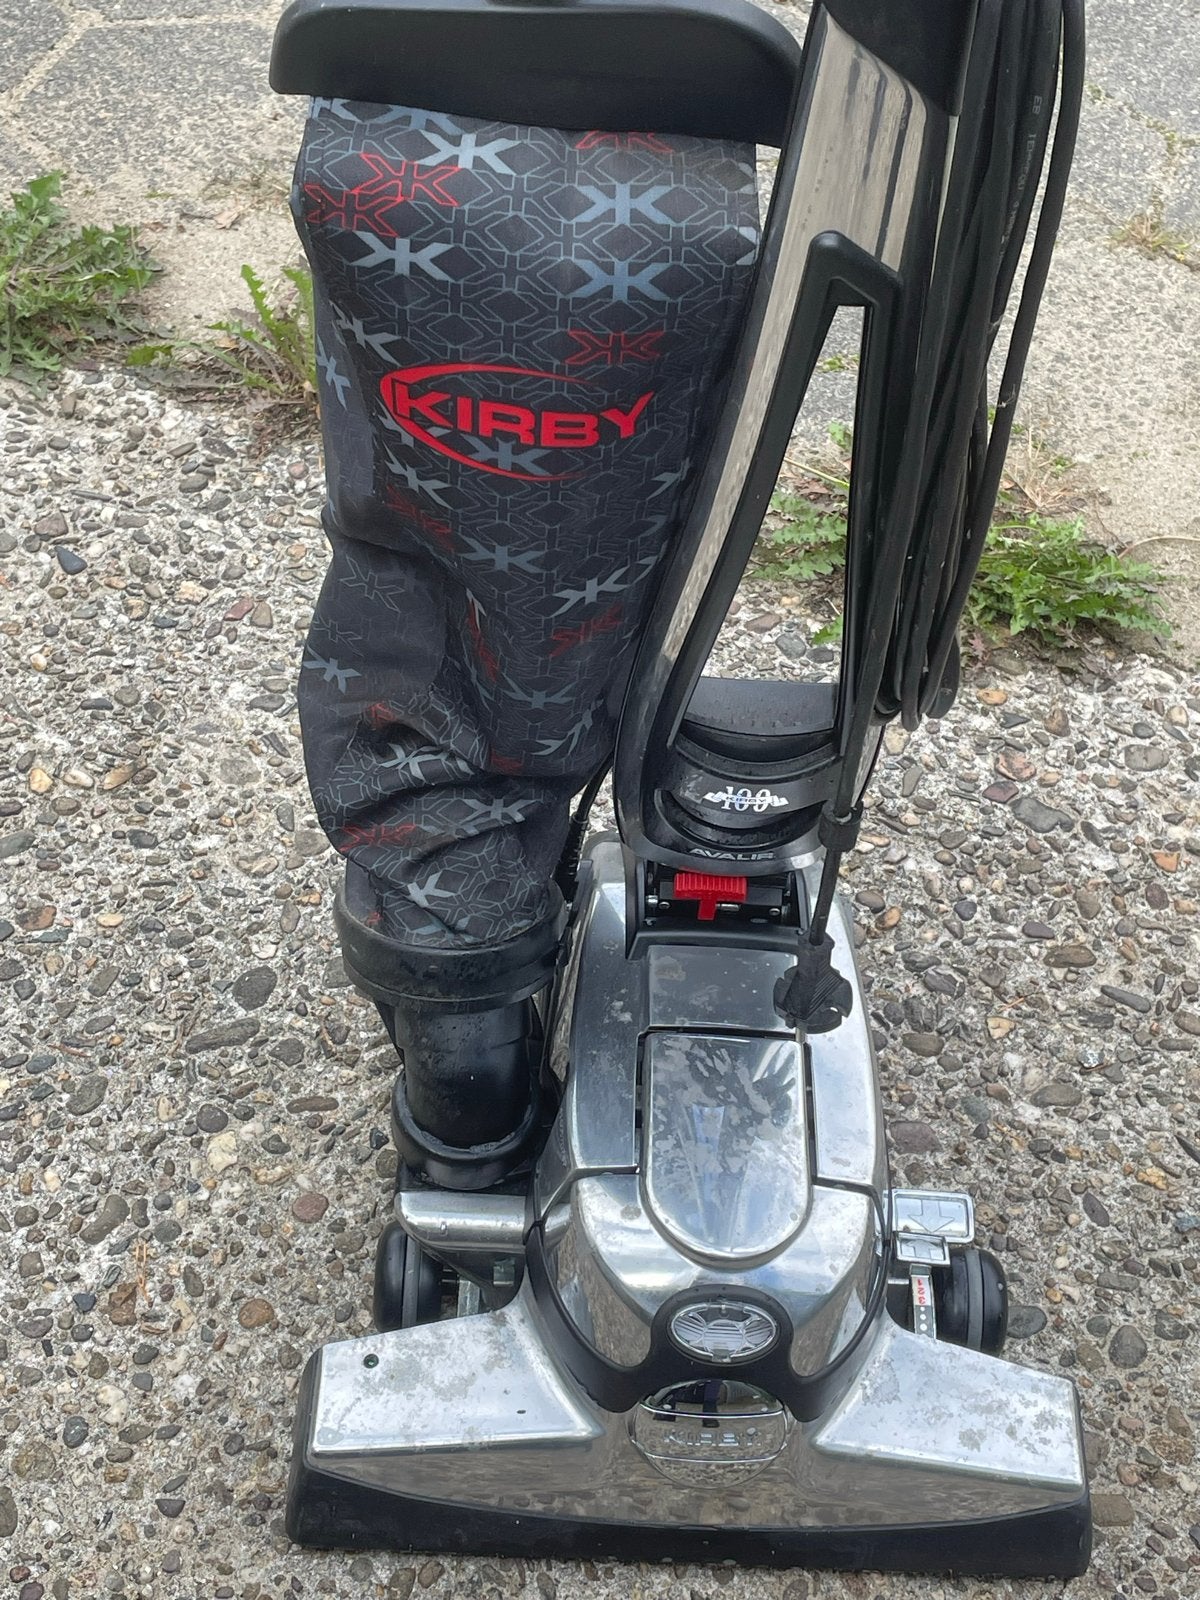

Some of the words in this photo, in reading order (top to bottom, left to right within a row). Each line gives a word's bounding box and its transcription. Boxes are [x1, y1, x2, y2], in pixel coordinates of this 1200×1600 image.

[395, 383, 655, 447] KIRBY
[720, 785, 771, 812] 100
[689, 848, 774, 860] AVALIR
